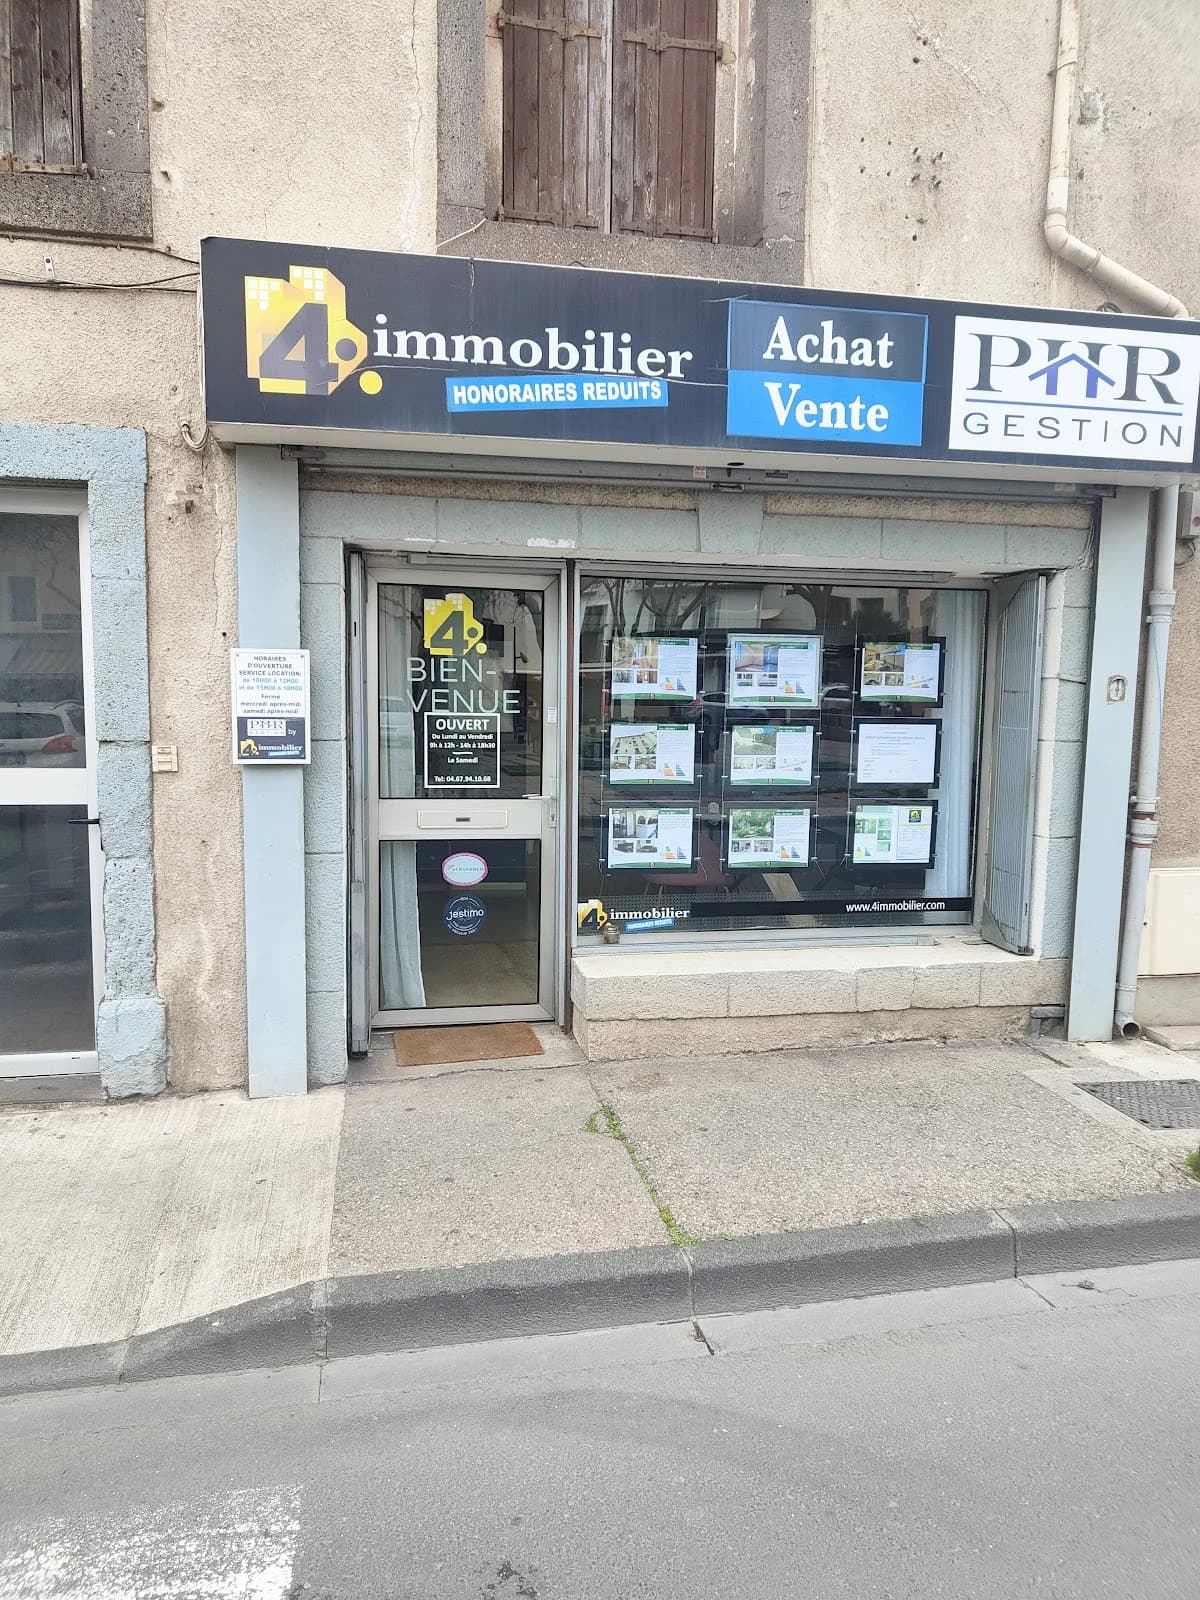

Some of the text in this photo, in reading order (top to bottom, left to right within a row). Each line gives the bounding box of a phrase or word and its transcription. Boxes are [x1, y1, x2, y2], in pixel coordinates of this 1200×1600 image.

[373, 314, 693, 379] immobilier
[763, 316, 894, 369] Achat
[965, 333, 1184, 405] PHR
[453, 380, 662, 405] HONORAIRES REDUITS
[763, 381, 889, 432] Vente
[963, 412, 1182, 448] GESTION
[406, 656, 497, 682] BIEN-
[406, 688, 521, 714] VENUE
[288, 728, 297, 736] by
[435, 718, 490, 731] OUVERT
[258, 743, 304, 751] immobilier
[455, 756, 479, 764] Samedi
[445, 909, 484, 921] jestimo
[610, 907, 691, 920] immobilier
[846, 900, 946, 912] www.4immobilier.com
